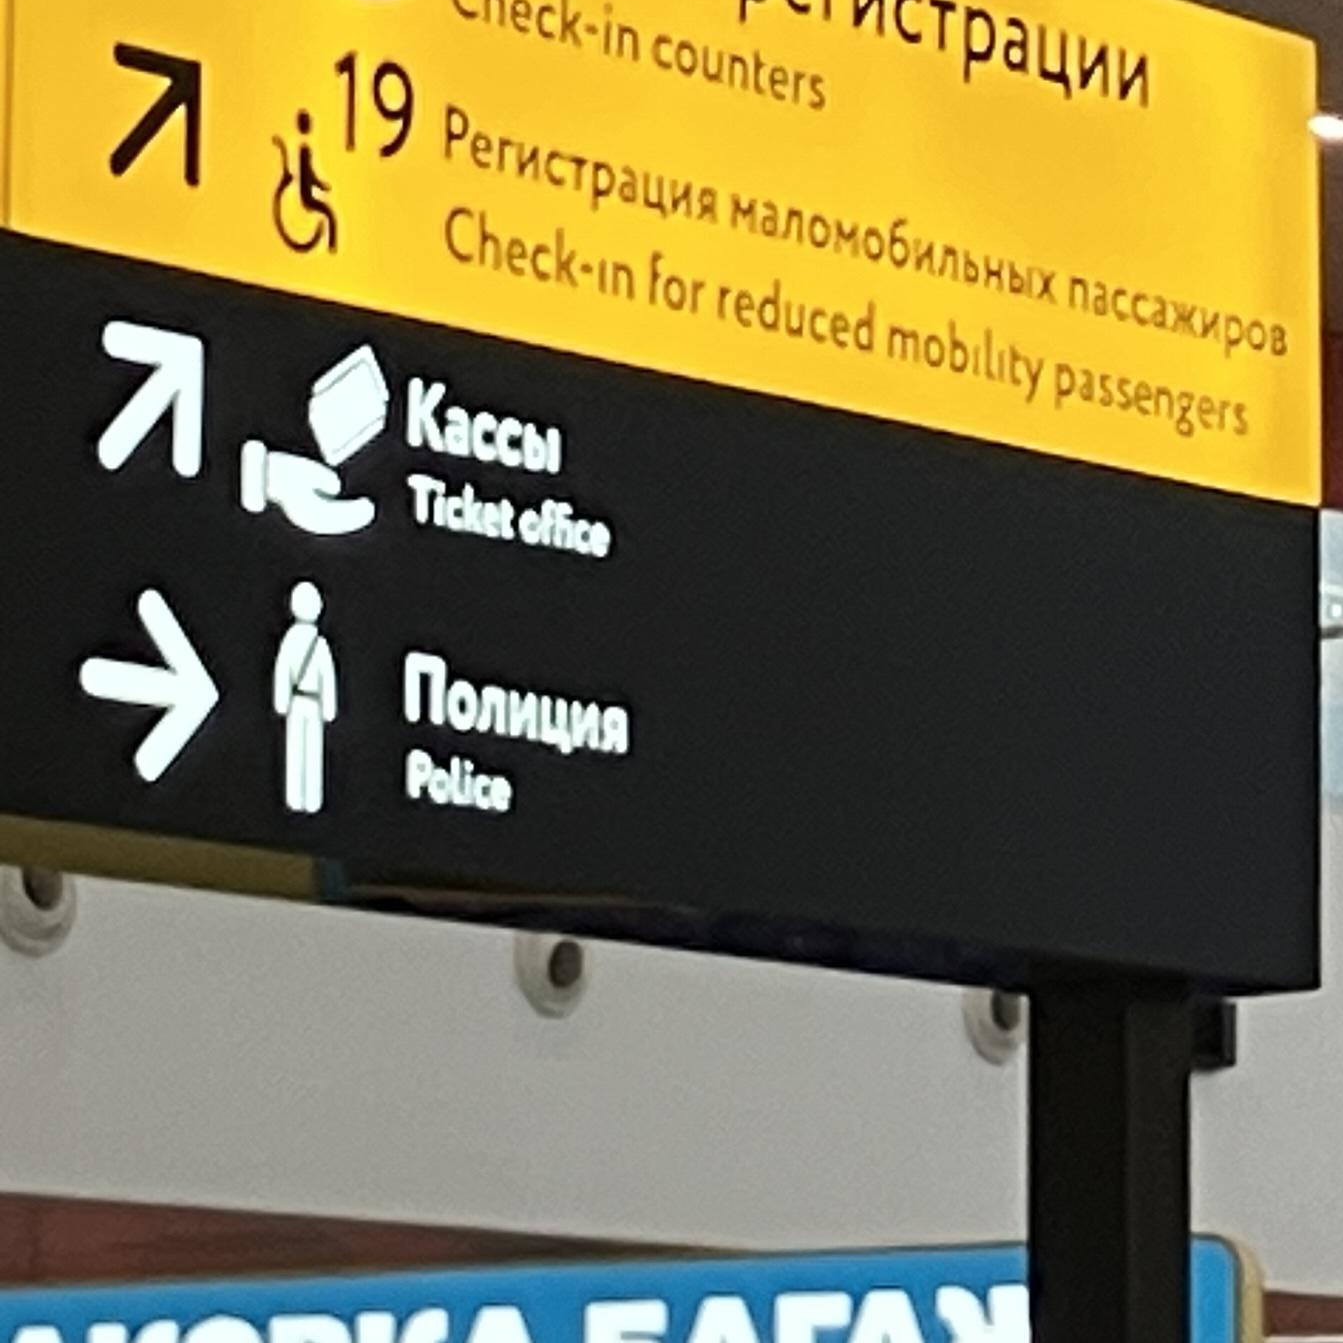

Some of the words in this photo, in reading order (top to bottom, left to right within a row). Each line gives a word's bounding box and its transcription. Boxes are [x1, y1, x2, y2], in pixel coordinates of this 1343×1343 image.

[334, 50, 414, 158] 19
[651, 32, 827, 111] counters
[444, 103, 718, 223] Регистрация
[730, 191, 1057, 305] маломобильных
[1067, 273, 1288, 358] пассажиров
[444, 206, 635, 302] Check-in
[648, 251, 705, 315] for
[716, 278, 876, 353] reduced
[886, 320, 1044, 405] mobility
[1054, 360, 1249, 439] passengers
[406, 376, 562, 475] Кассы
[406, 472, 516, 541] Ticket
[518, 499, 612, 559] office
[404, 651, 630, 755] Полиция
[406, 748, 513, 813] Police
